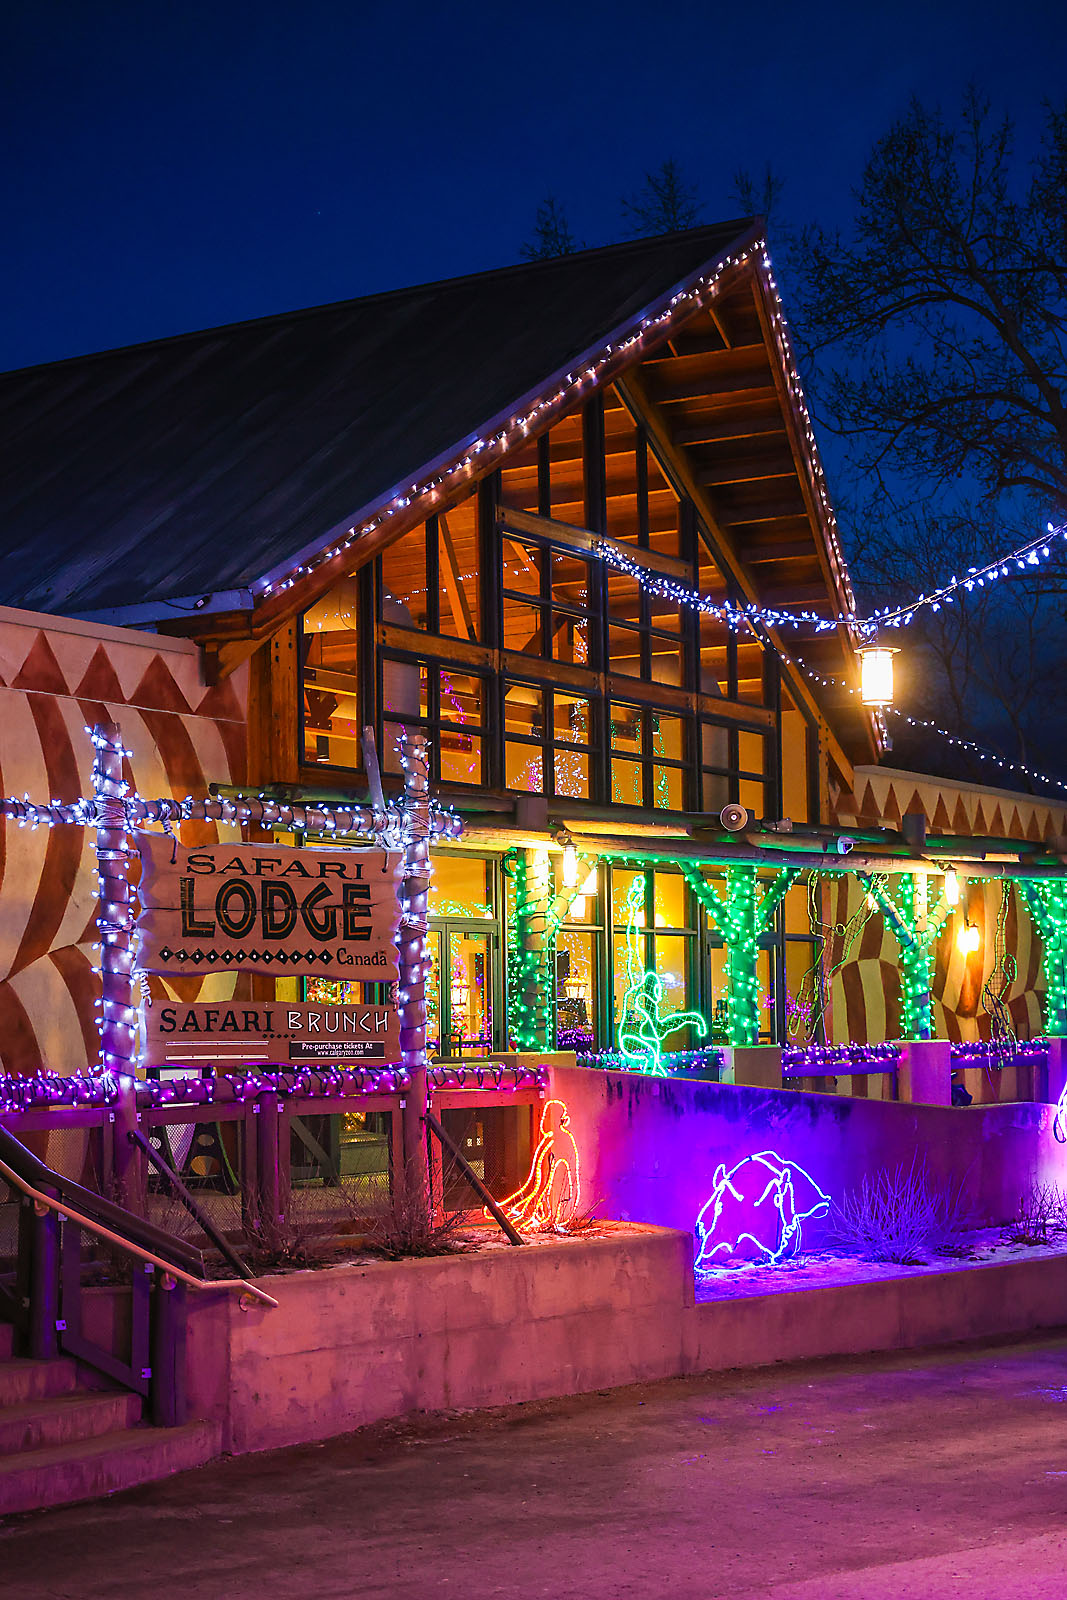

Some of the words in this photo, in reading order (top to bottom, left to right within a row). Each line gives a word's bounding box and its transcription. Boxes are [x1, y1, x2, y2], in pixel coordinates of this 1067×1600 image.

[186, 854, 364, 879] SAFARI
[180, 877, 373, 942] LODGE
[336, 947, 387, 966] Canada
[160, 1009, 274, 1033] SAFARI
[286, 1010, 389, 1033] BRUNCH
[302, 1042, 342, 1051] Pre-purchase
[343, 1042, 363, 1050] tickets
